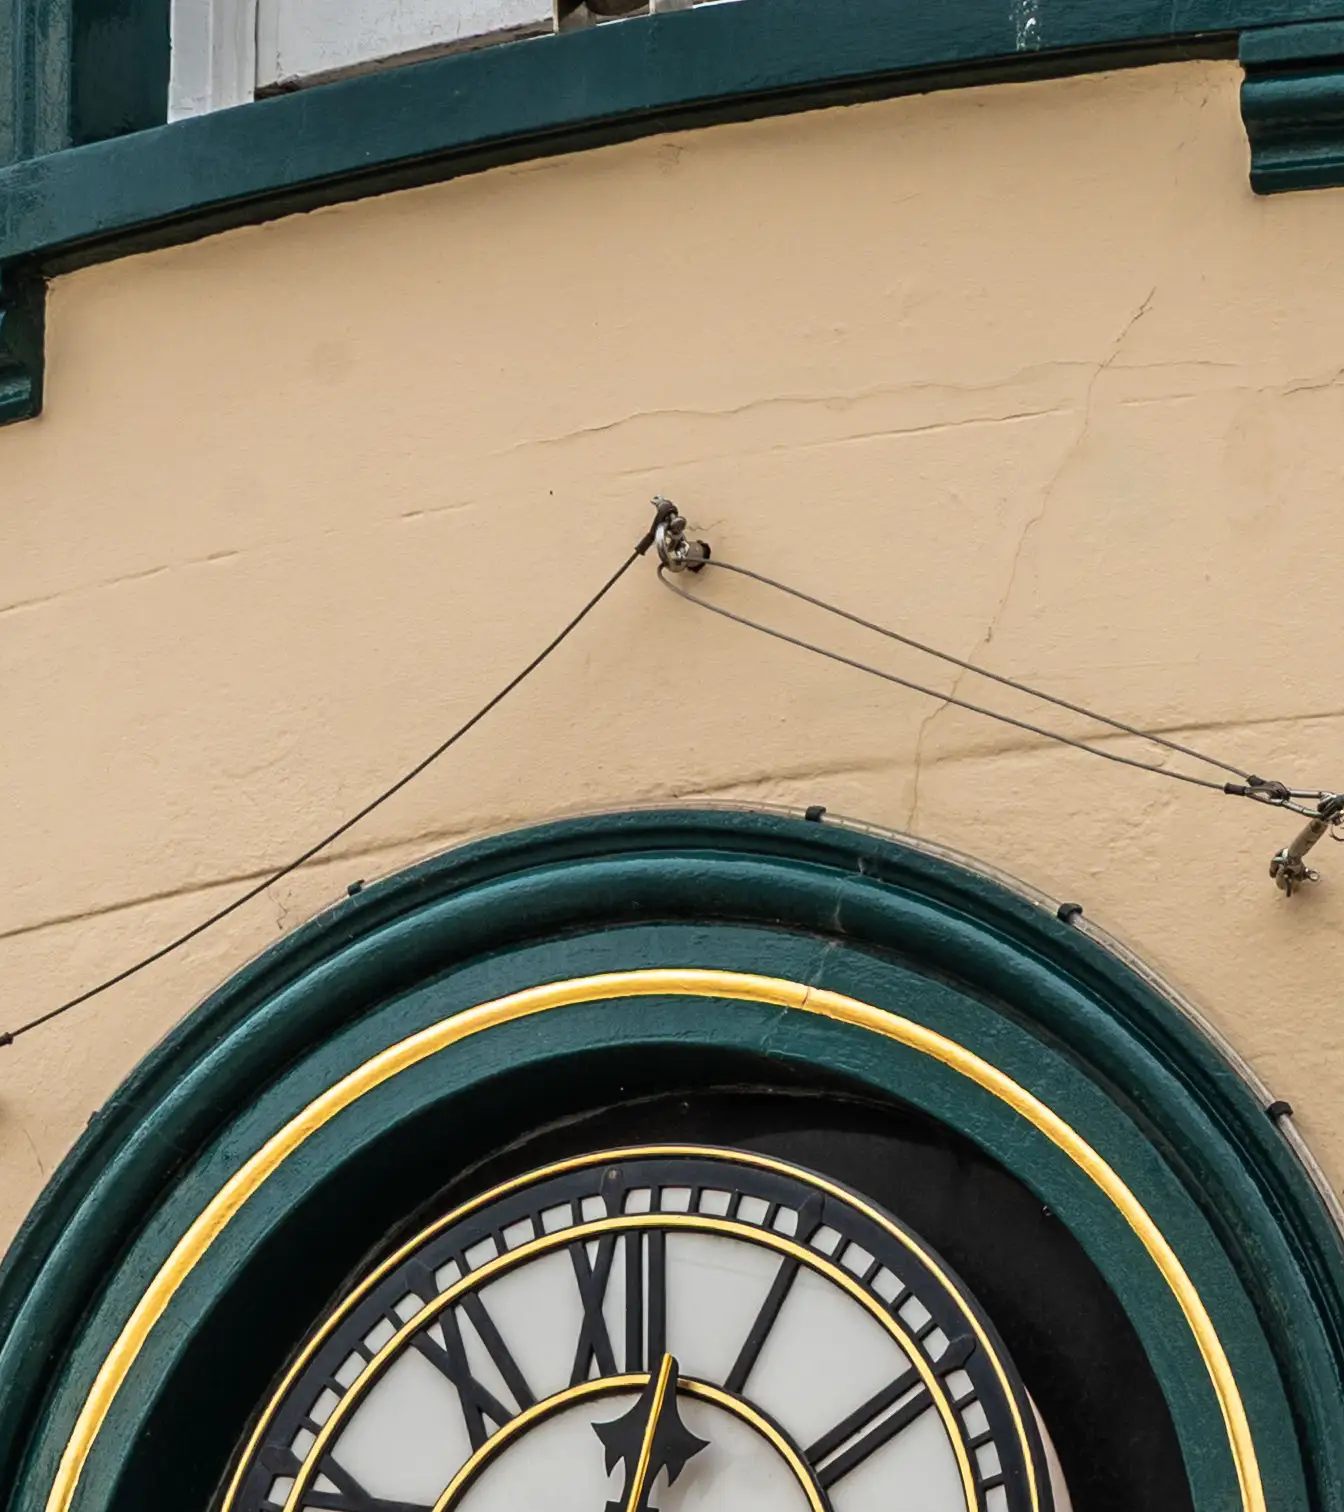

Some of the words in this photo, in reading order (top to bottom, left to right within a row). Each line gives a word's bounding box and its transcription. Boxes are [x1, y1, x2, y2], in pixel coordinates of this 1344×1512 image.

[412, 1292, 535, 1450] XI
[570, 1228, 666, 1380] XII
[728, 1256, 800, 1392] I
[804, 1368, 935, 1488] II
